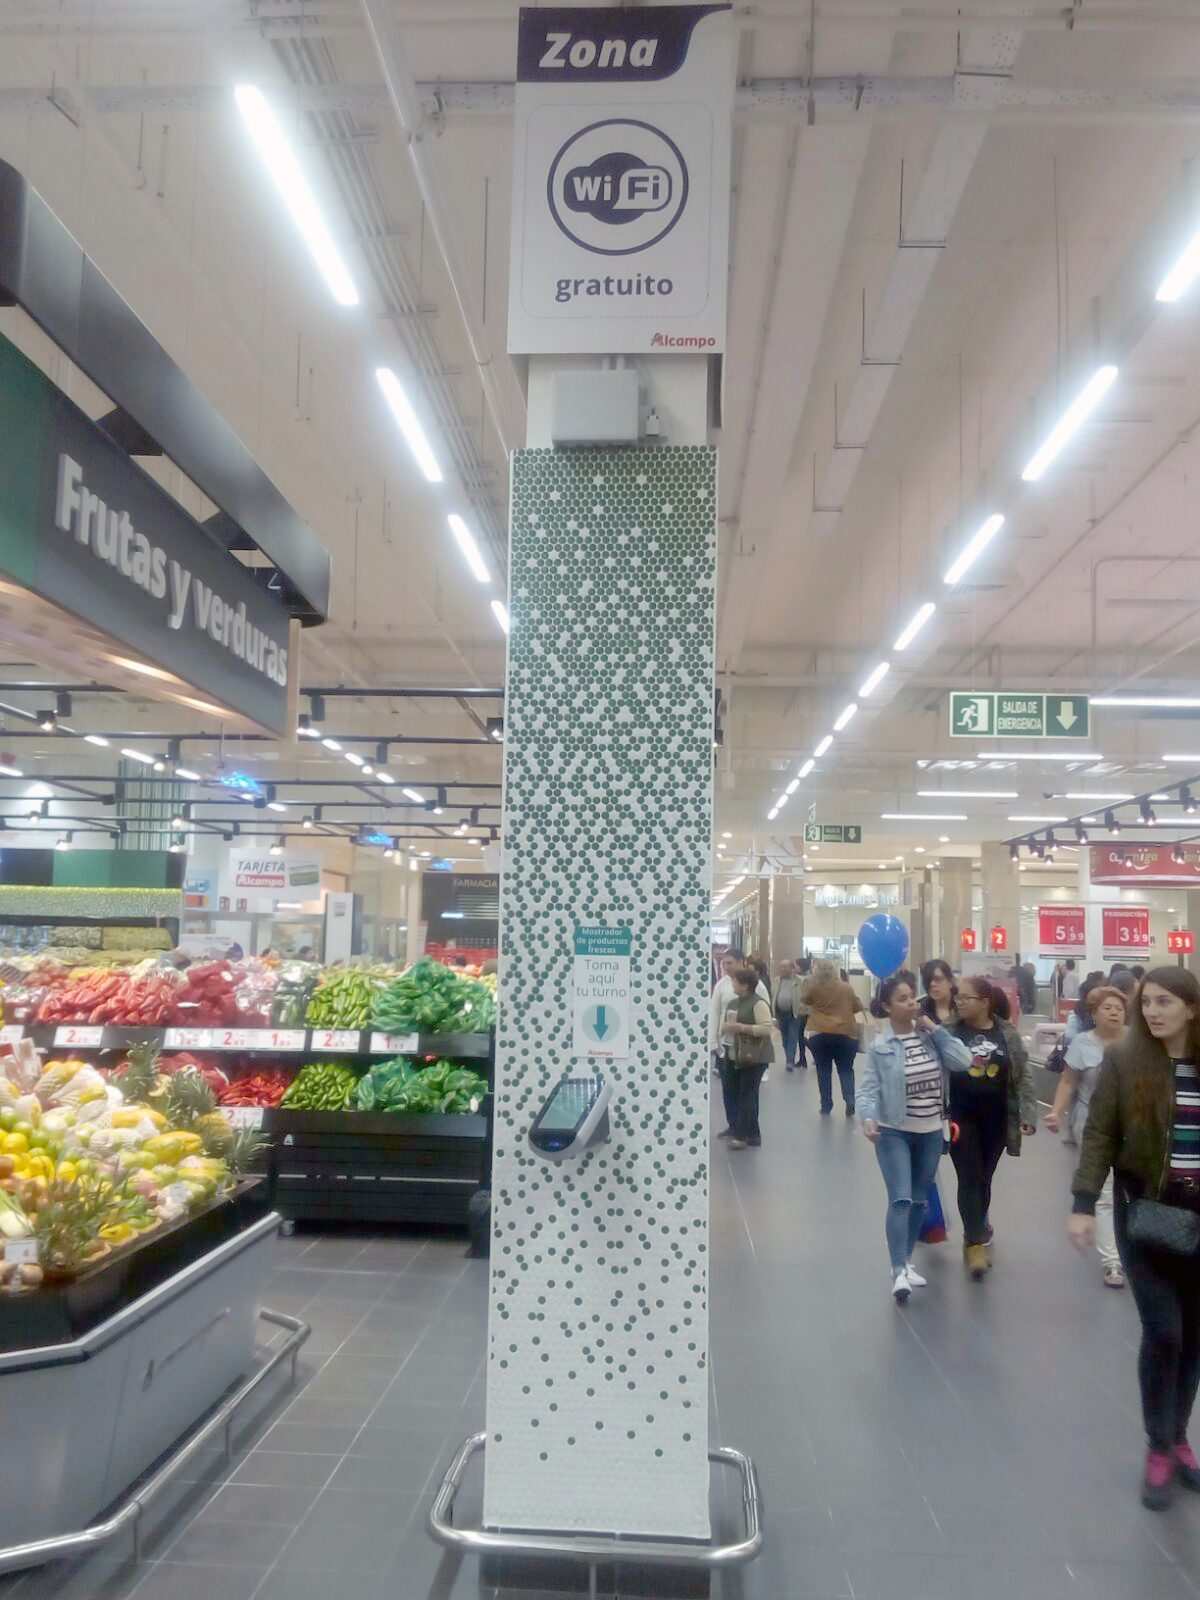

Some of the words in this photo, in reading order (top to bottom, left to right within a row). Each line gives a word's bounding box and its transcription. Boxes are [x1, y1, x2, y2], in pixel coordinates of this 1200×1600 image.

[538, 33, 658, 68] Zona
[555, 273, 673, 302] gratuito
[651, 333, 716, 348] Alcampo
[56, 452, 167, 599] Frutas
[167, 560, 191, 630] y
[192, 578, 287, 687] verduras
[1002, 701, 1027, 714] SALIDA
[1028, 702, 1038, 714] DE
[998, 717, 1042, 730] EMERGENCIA
[237, 861, 285, 873] TARJETA
[238, 875, 284, 888] Alcampo
[454, 879, 497, 888] FARMACIA
[581, 927, 622, 935] Mostrador
[588, 937, 628, 945] productos
[588, 945, 616, 954] frescos
[584, 959, 619, 970] Toma
[588, 972, 615, 986] aquí
[576, 987, 588, 997] tu
[592, 987, 627, 997] turno
